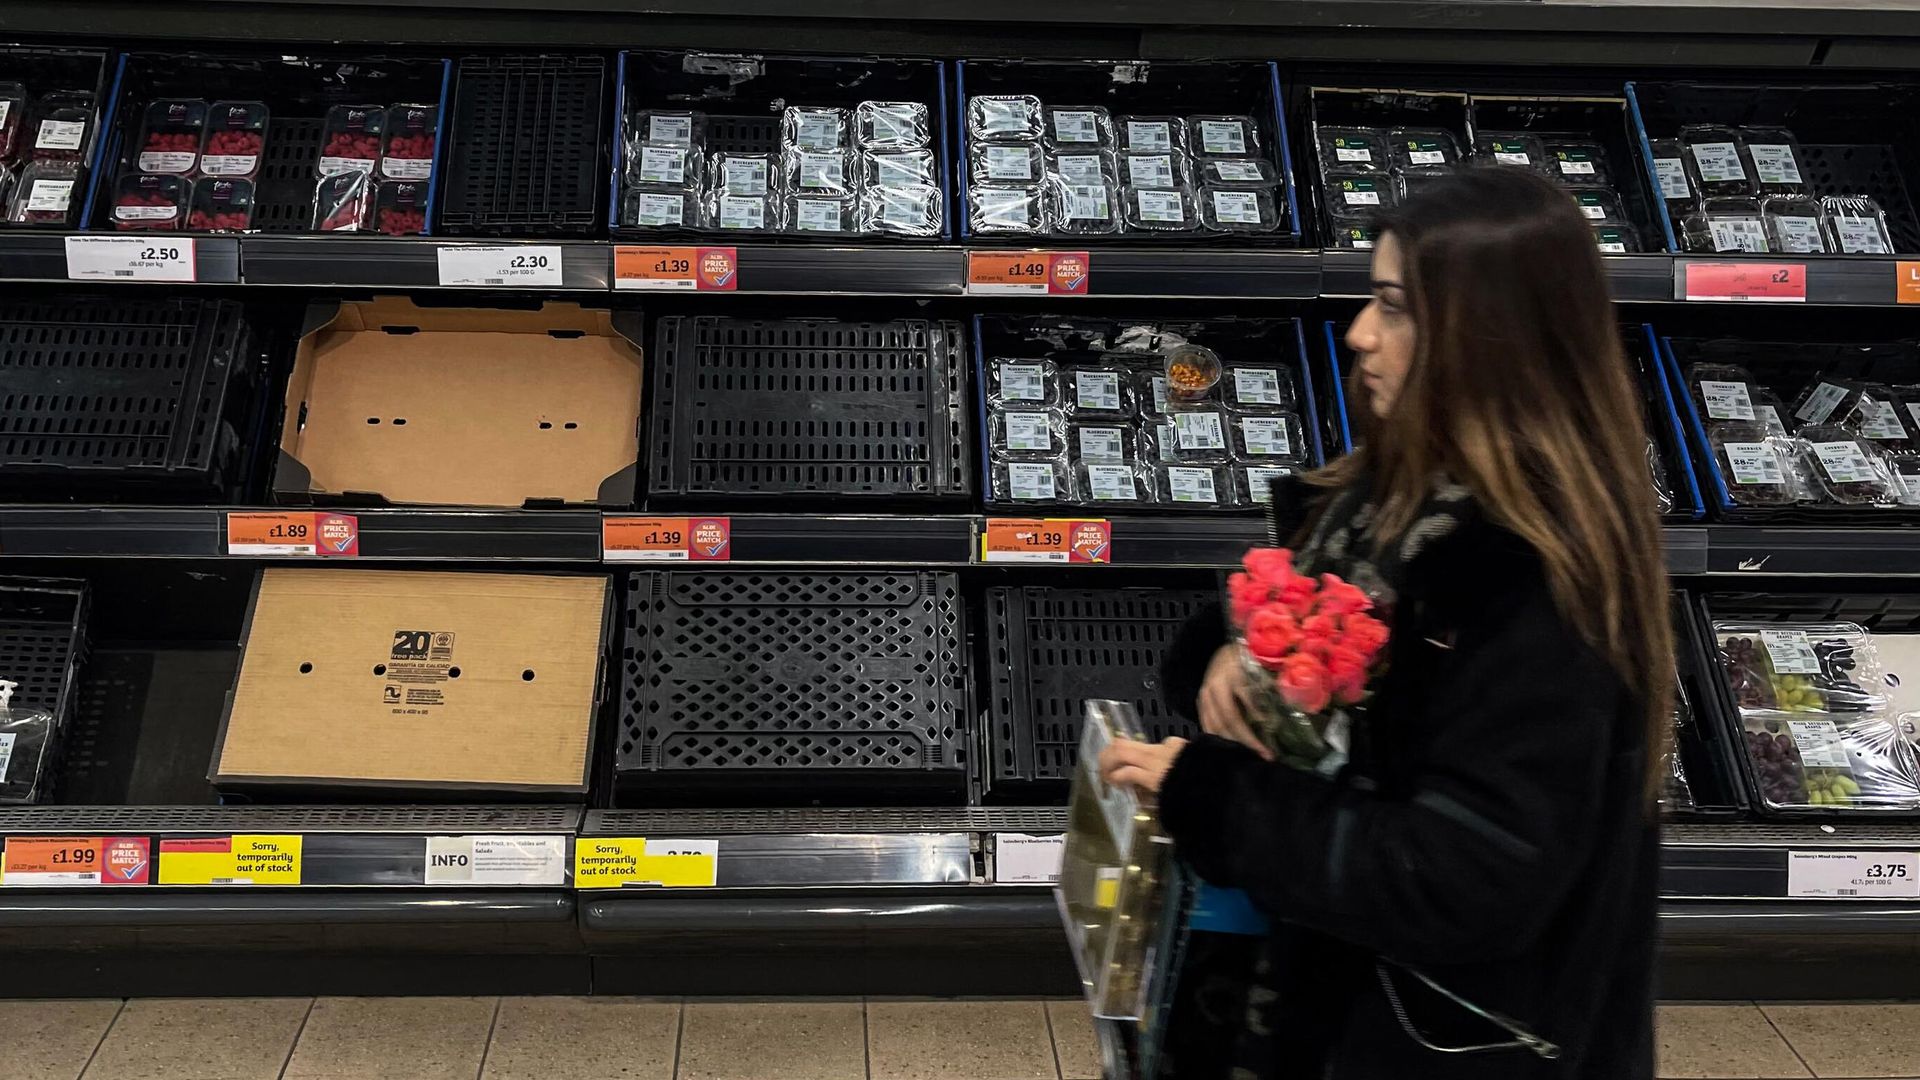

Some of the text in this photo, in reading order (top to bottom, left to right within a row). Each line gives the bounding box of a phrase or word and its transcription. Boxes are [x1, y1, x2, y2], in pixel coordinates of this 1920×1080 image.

[141, 247, 179, 261] £2.50
[510, 255, 548, 269] £2.30
[655, 259, 690, 273] £1.39
[1008, 263, 1044, 276] £1.49
[1772, 269, 1789, 283] £2
[269, 524, 307, 538] £1.89
[645, 531, 681, 545] £1.39
[1026, 532, 1062, 546] £1.39
[1078, 538, 1102, 546] MATCH
[393, 631, 431, 655] 20
[112, 849, 139, 857] PRICE
[251, 842, 280, 853] Sorry,
[595, 844, 623, 855] Sorry,
[52, 848, 95, 864] £1.99
[237, 853, 294, 864] temporarily
[431, 854, 469, 867] INFO
[581, 855, 637, 866] temporarily
[236, 863, 293, 872] out of stock
[581, 866, 637, 875] out of stock
[1866, 864, 1907, 878] £3.75
